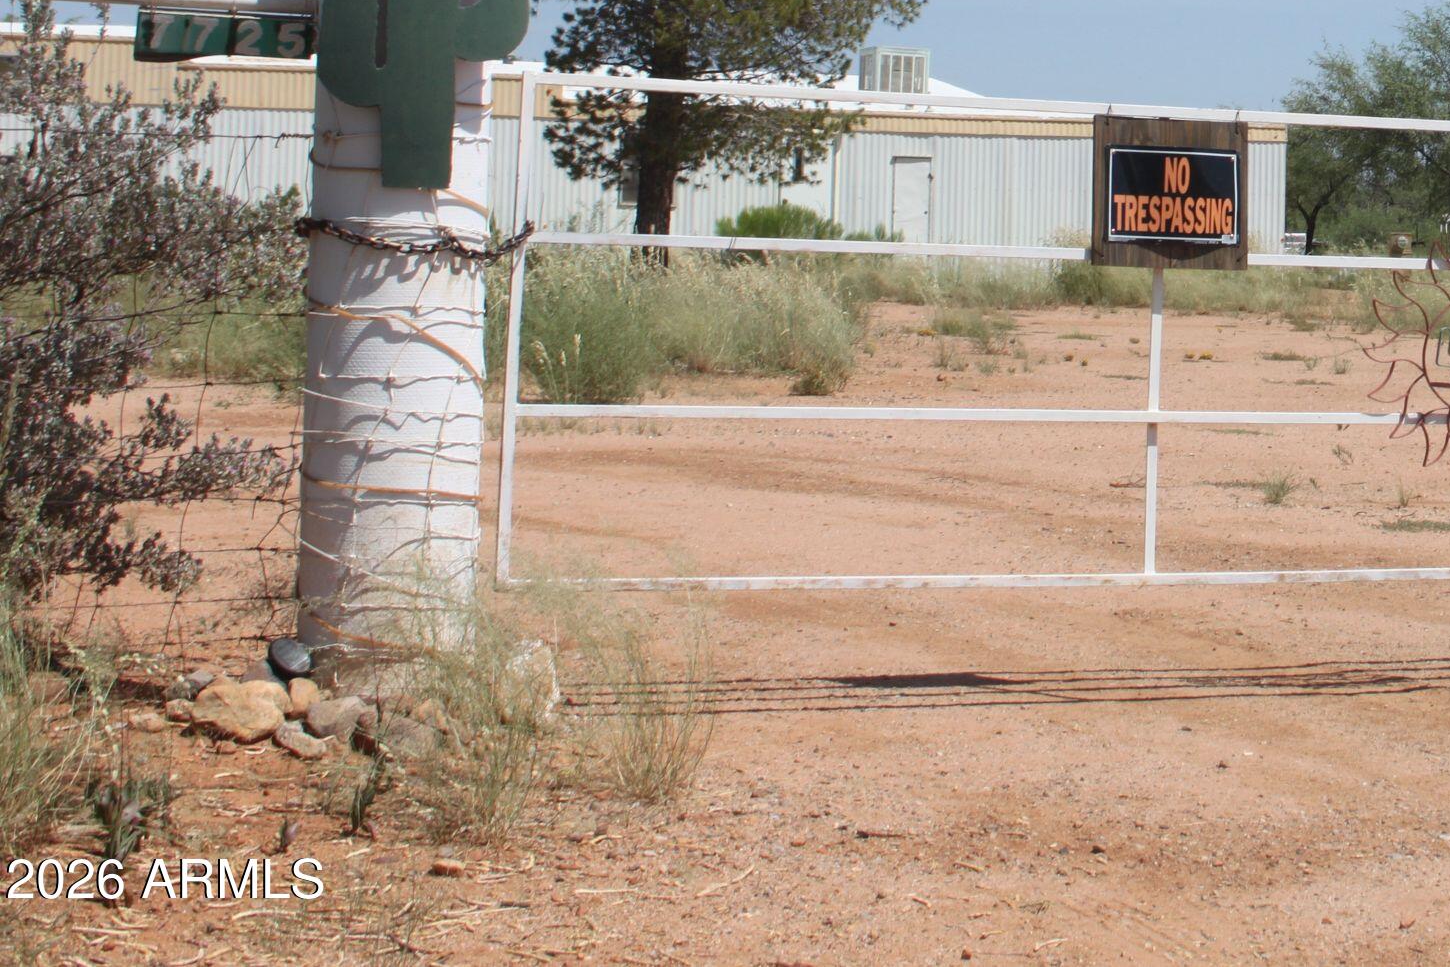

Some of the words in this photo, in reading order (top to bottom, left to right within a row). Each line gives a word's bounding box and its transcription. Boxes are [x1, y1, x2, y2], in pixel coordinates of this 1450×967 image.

[149, 15, 305, 58] 7725
[1164, 156, 1190, 194] NO
[1113, 194, 1233, 234] TRESPASSING
